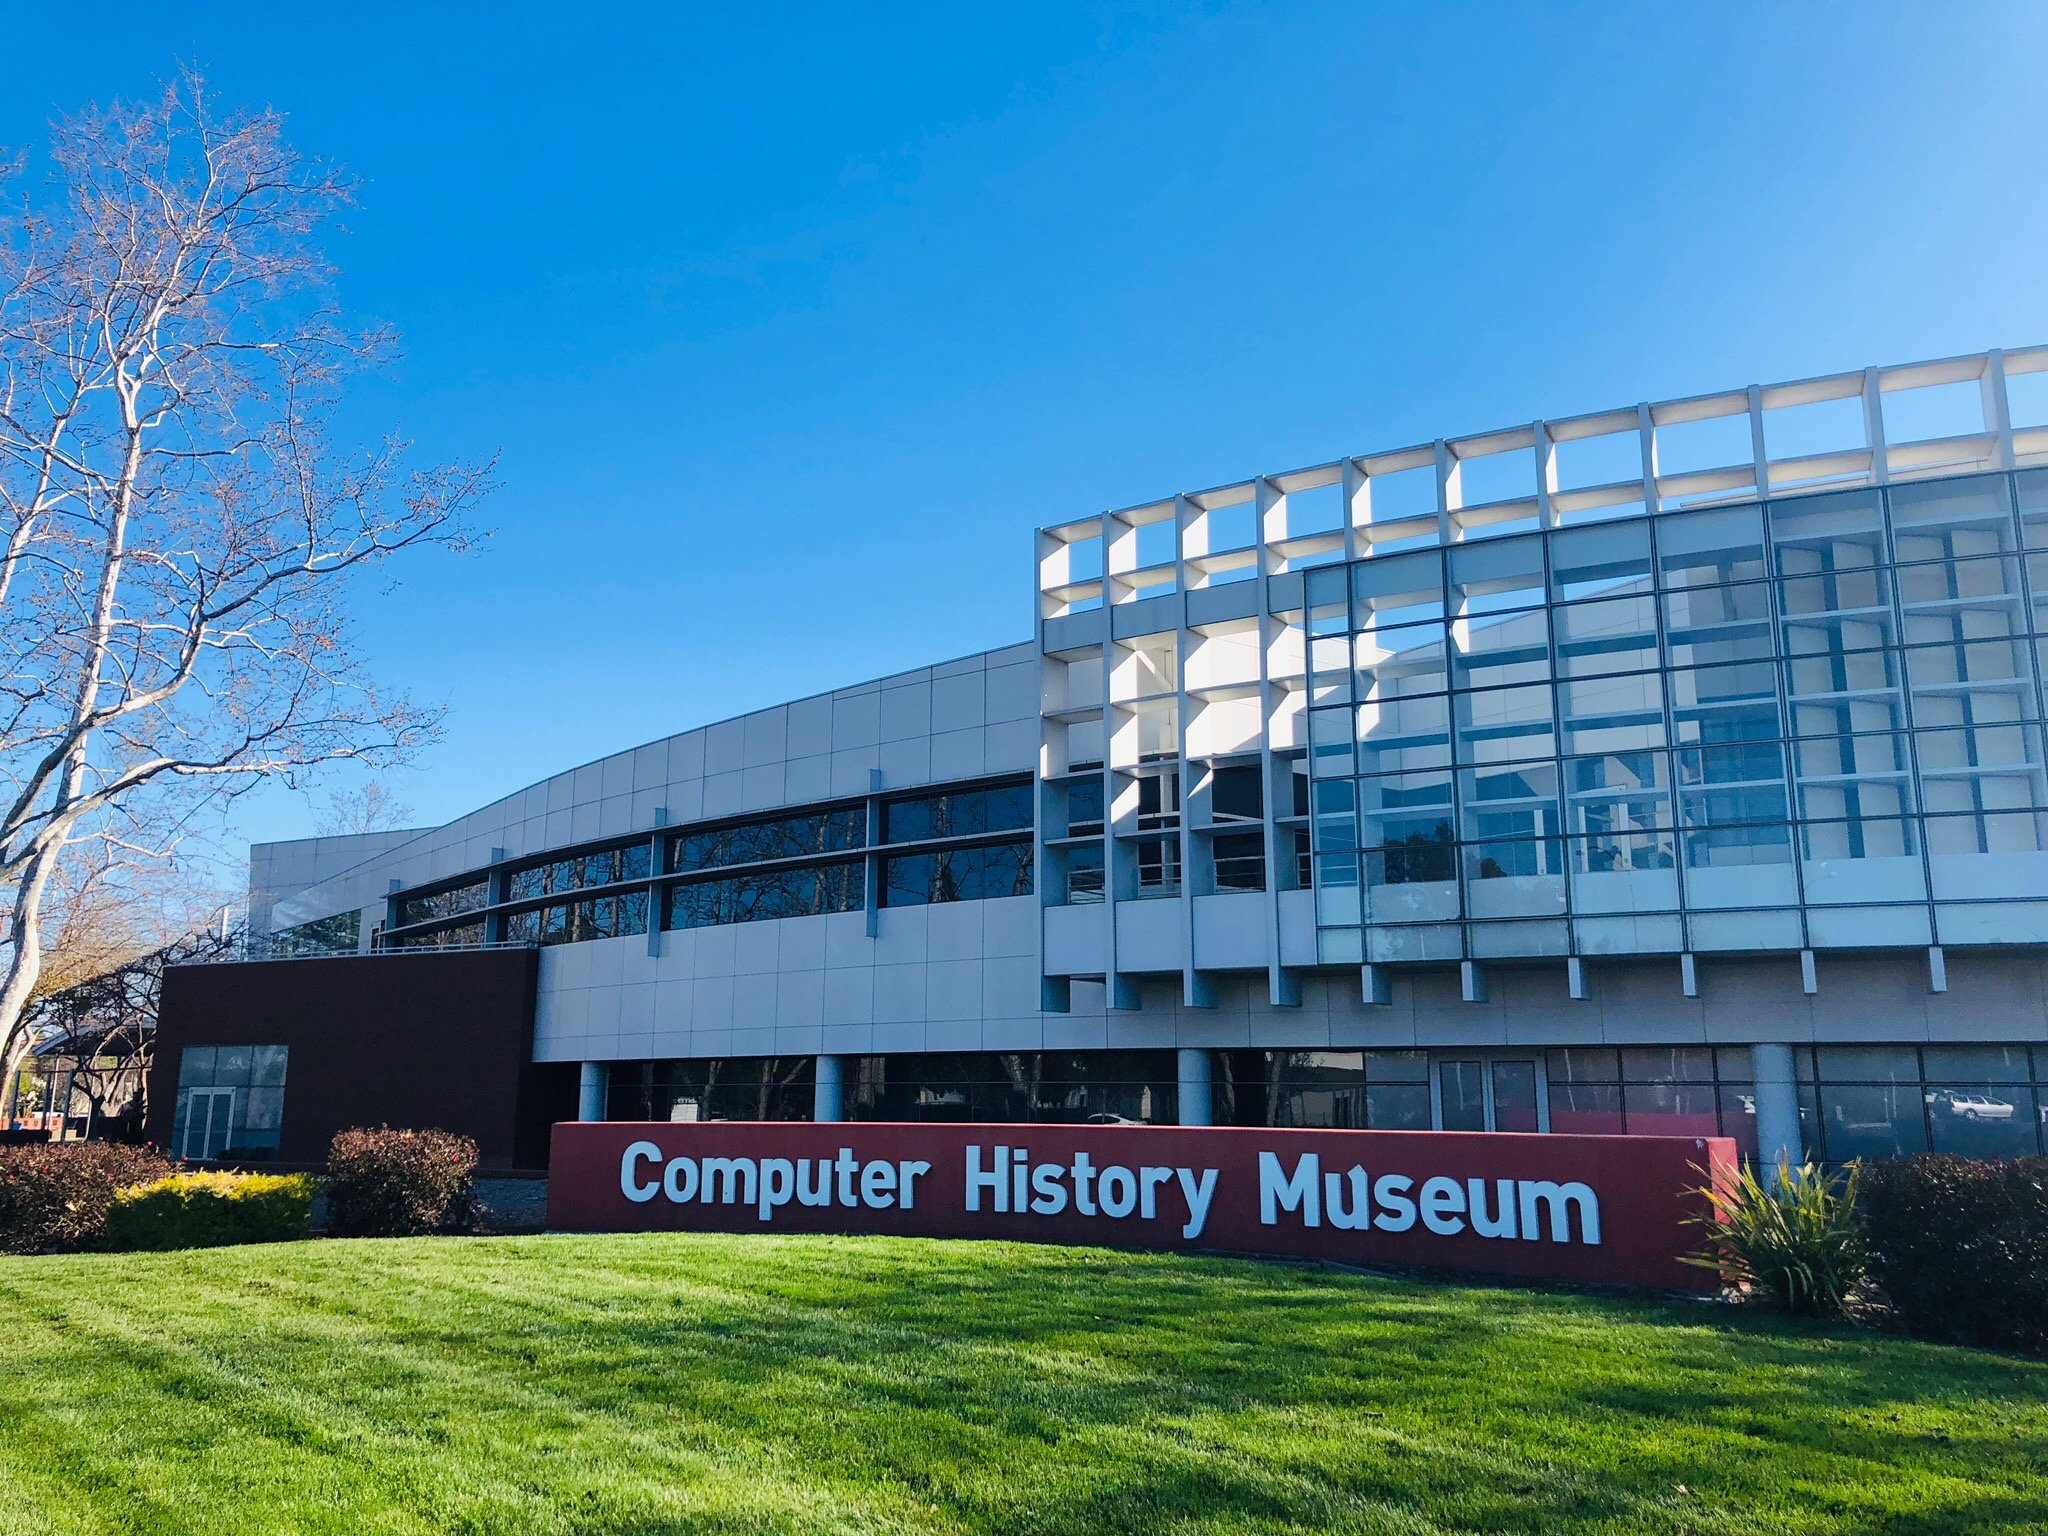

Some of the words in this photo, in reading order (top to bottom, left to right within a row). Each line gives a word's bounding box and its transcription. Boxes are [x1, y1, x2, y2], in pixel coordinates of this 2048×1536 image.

[620, 1141, 932, 1220] Computer
[965, 1145, 1220, 1239] History
[1258, 1151, 1602, 1246] Museum
